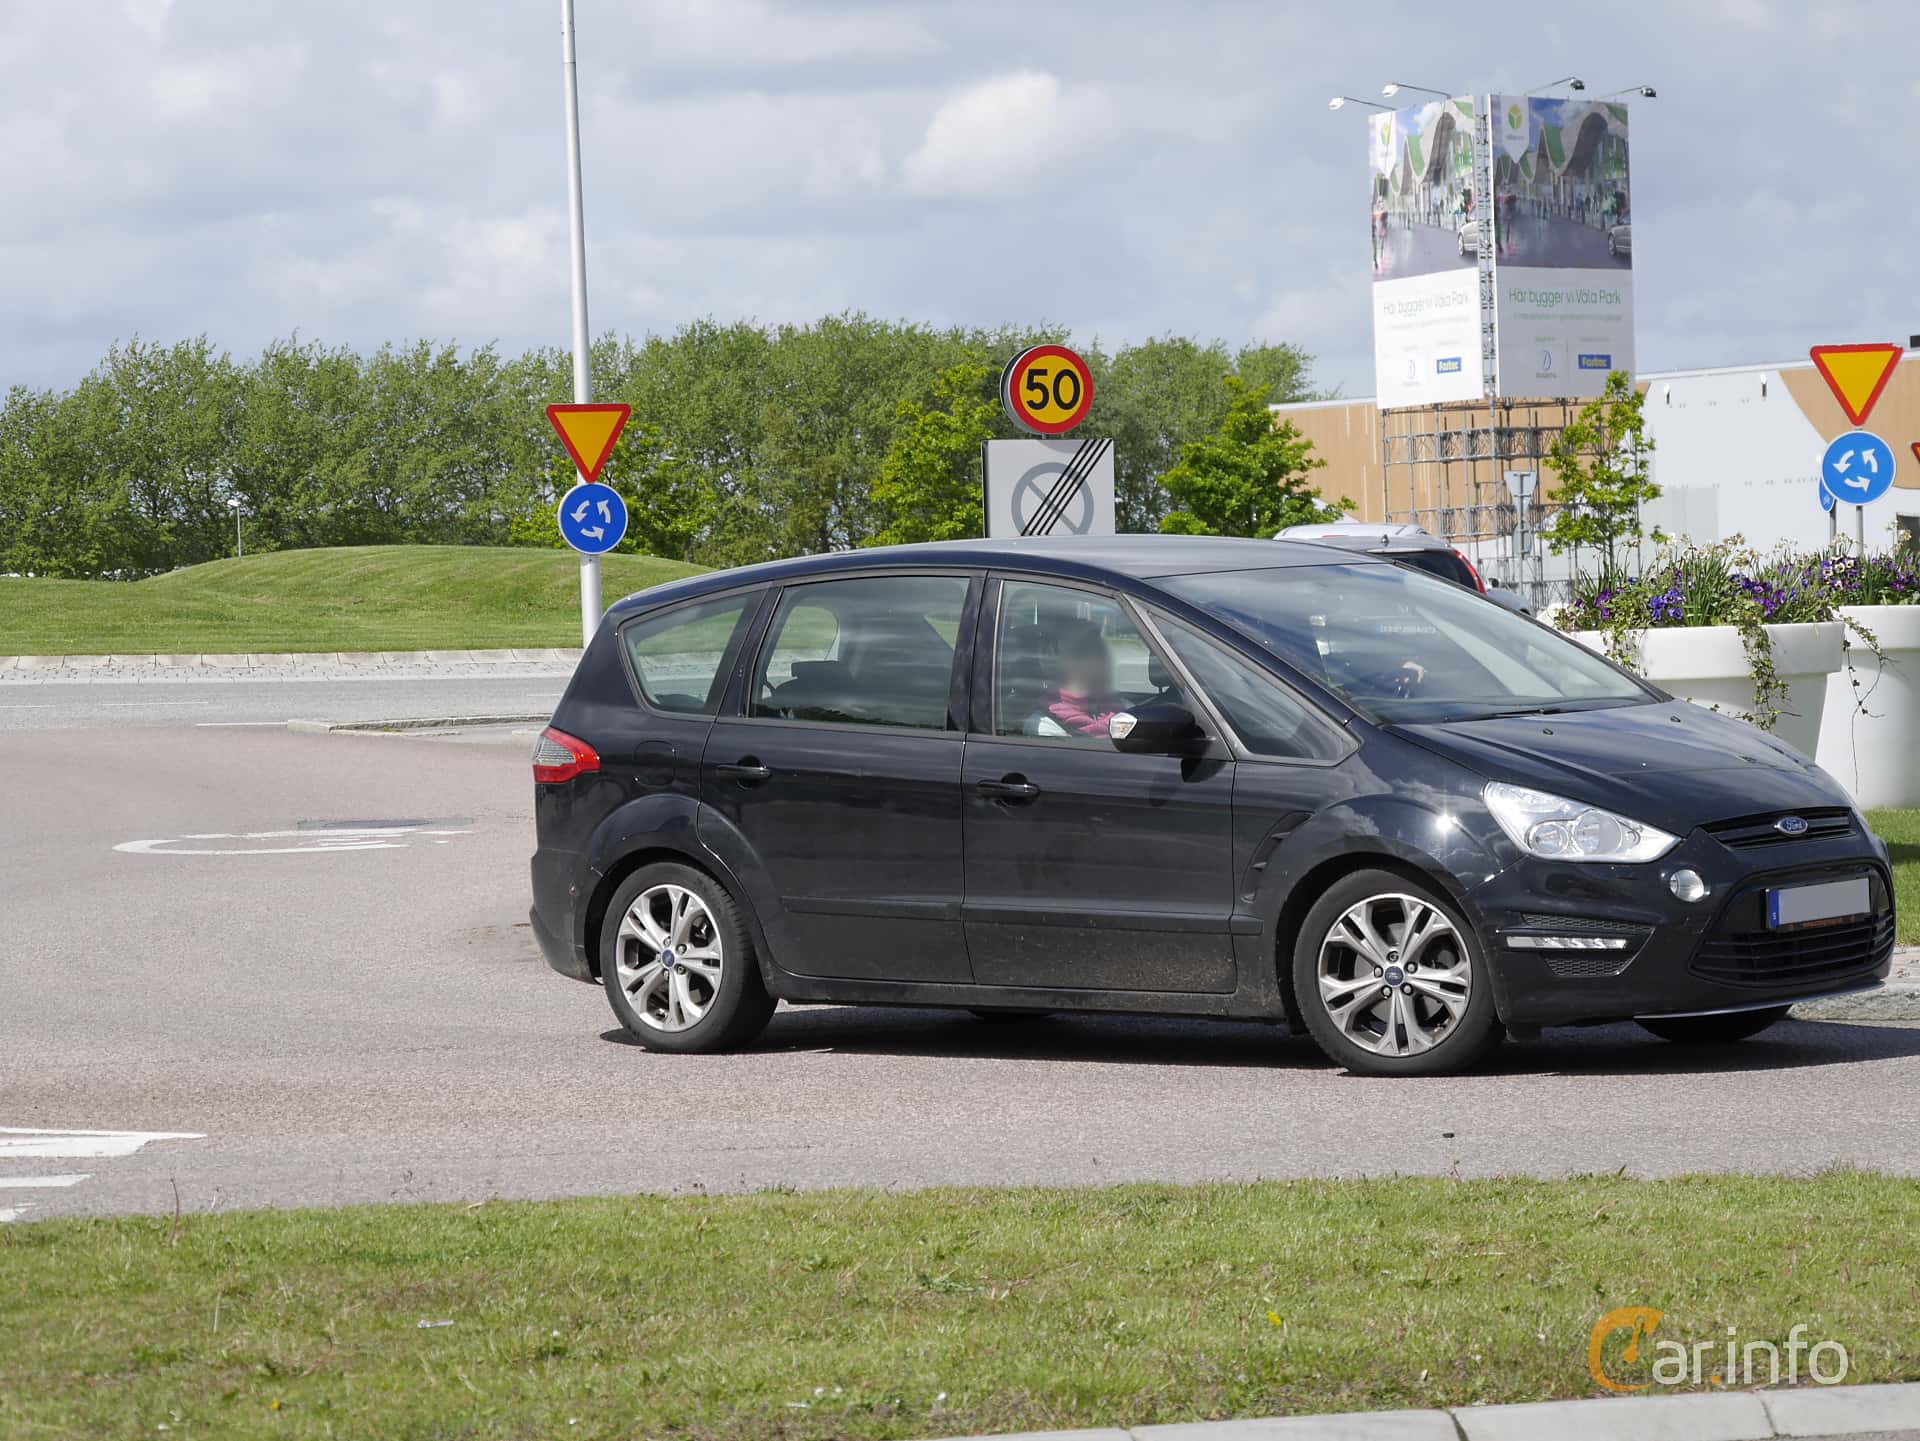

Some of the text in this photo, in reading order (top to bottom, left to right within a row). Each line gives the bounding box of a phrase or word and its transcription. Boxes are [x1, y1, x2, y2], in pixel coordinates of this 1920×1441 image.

[1528, 288, 1563, 307] bygger
[1598, 289, 1622, 305] Park
[1026, 369, 1080, 410] 50
